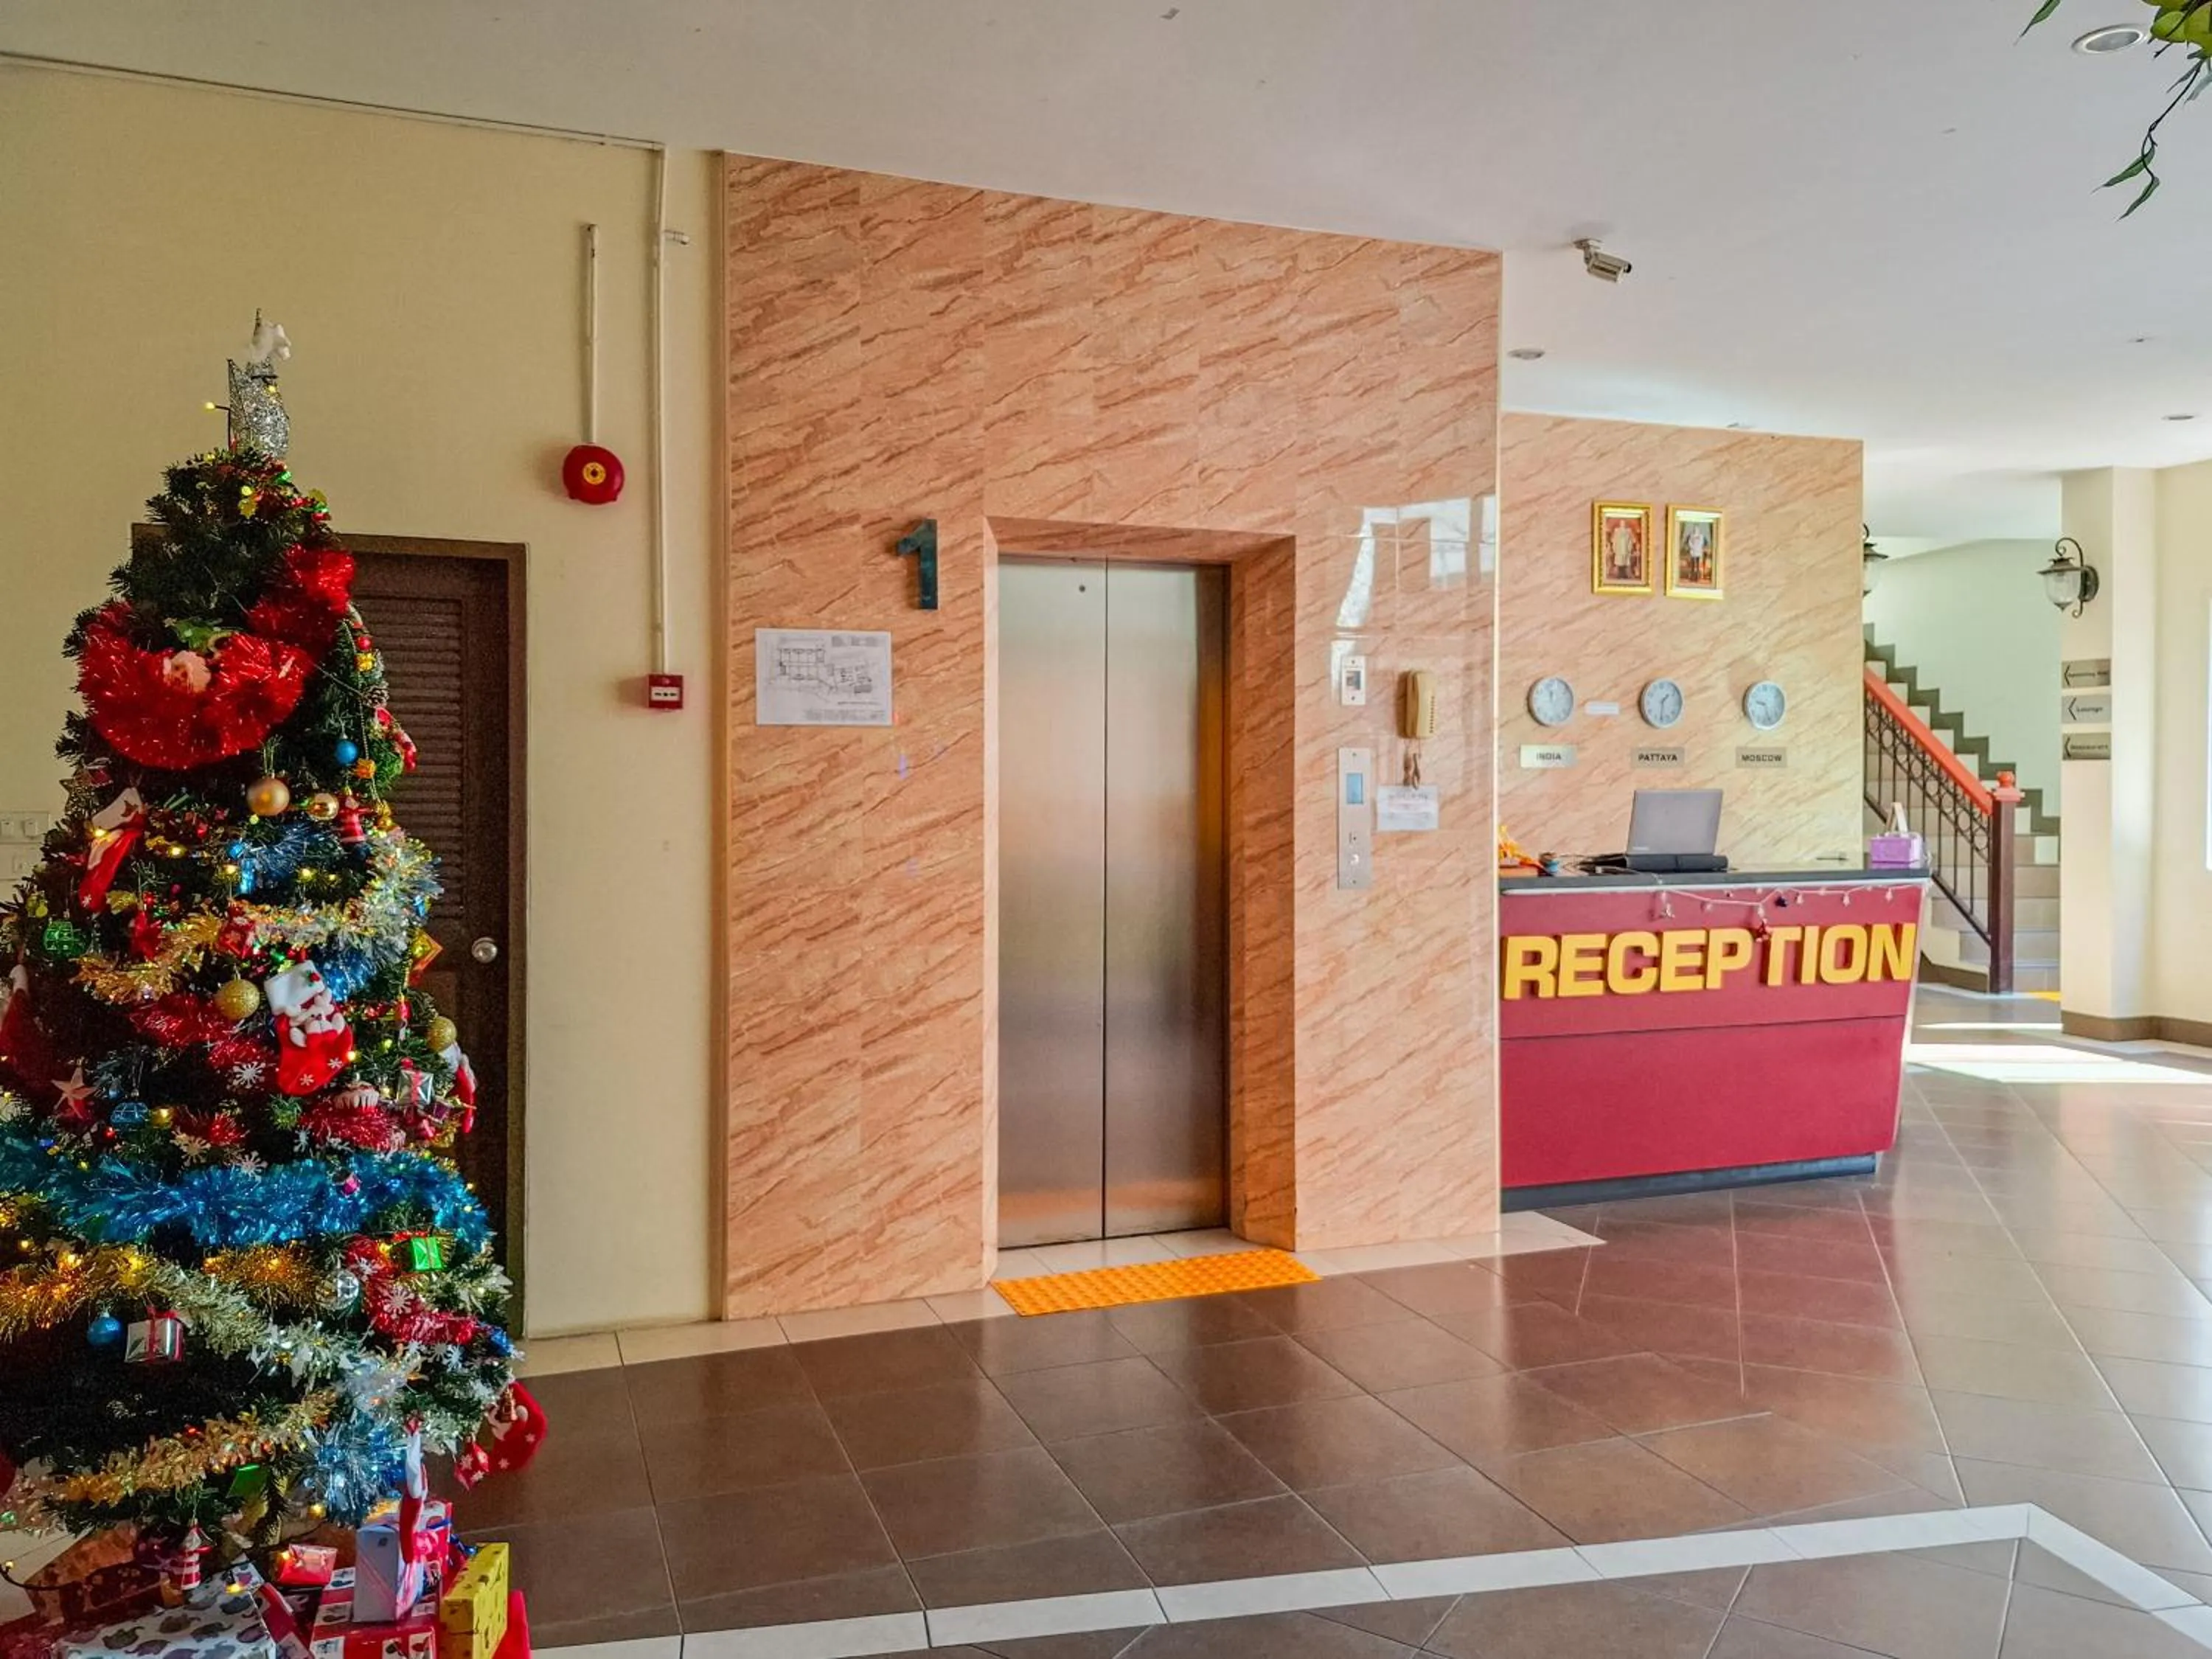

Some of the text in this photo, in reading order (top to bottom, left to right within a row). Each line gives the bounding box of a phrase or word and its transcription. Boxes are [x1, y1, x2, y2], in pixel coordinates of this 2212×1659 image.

[897, 518, 938, 610] 1
[1536, 752, 1562, 761] INDIA
[1638, 753, 1678, 762] PATTAYA
[1741, 754, 1783, 762] MOSCOW
[1501, 922, 1917, 1001] RECEPTION
